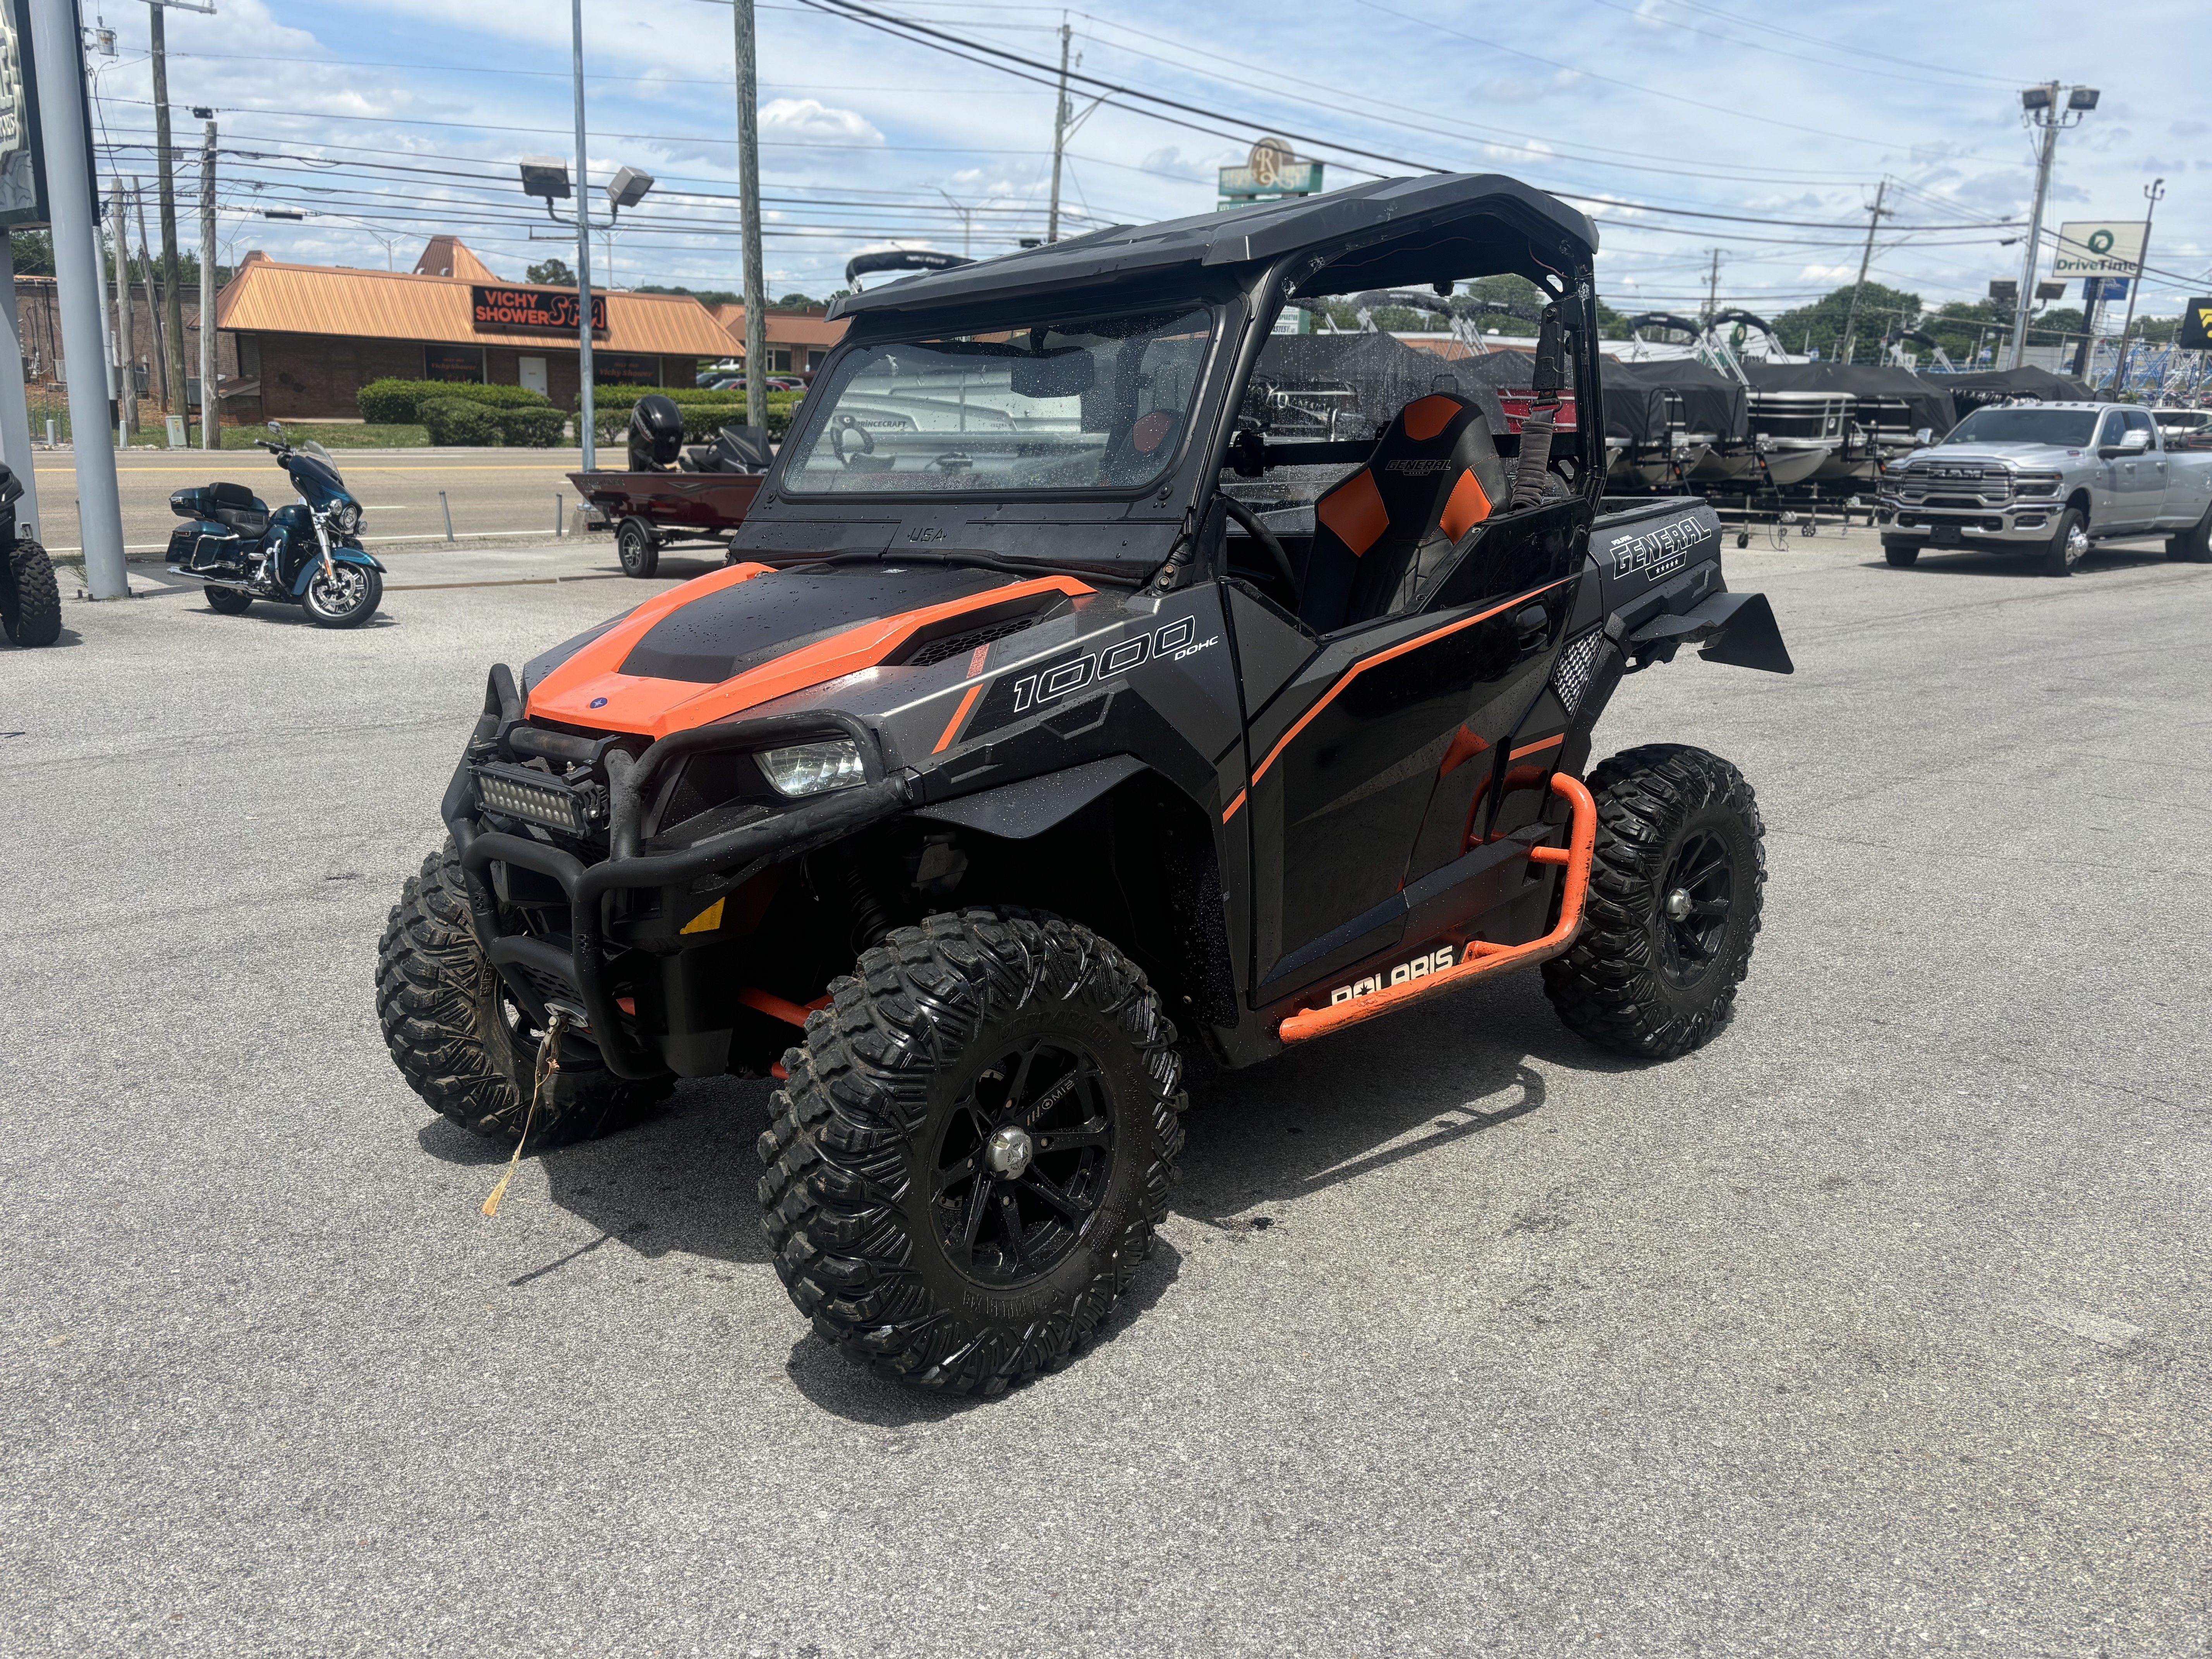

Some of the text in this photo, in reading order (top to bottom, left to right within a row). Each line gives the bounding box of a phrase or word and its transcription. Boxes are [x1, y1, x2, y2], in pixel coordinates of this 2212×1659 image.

[2056, 258, 2138, 270] DriveTime
[485, 290, 538, 308] VICHY
[476, 296, 604, 328] SHOWER SPA
[635, 410, 654, 440] MERCURY
[1385, 460, 1451, 470] GENERAL
[1928, 469, 1982, 477] RAM
[910, 528, 943, 542] USA
[1611, 535, 1633, 546] POLARIS
[1609, 516, 1711, 580] GENERAL
[1014, 615, 1219, 713] 1000 DOHC
[1331, 945, 1453, 1006] POLARIS
[1051, 1080, 1075, 1101] M12
